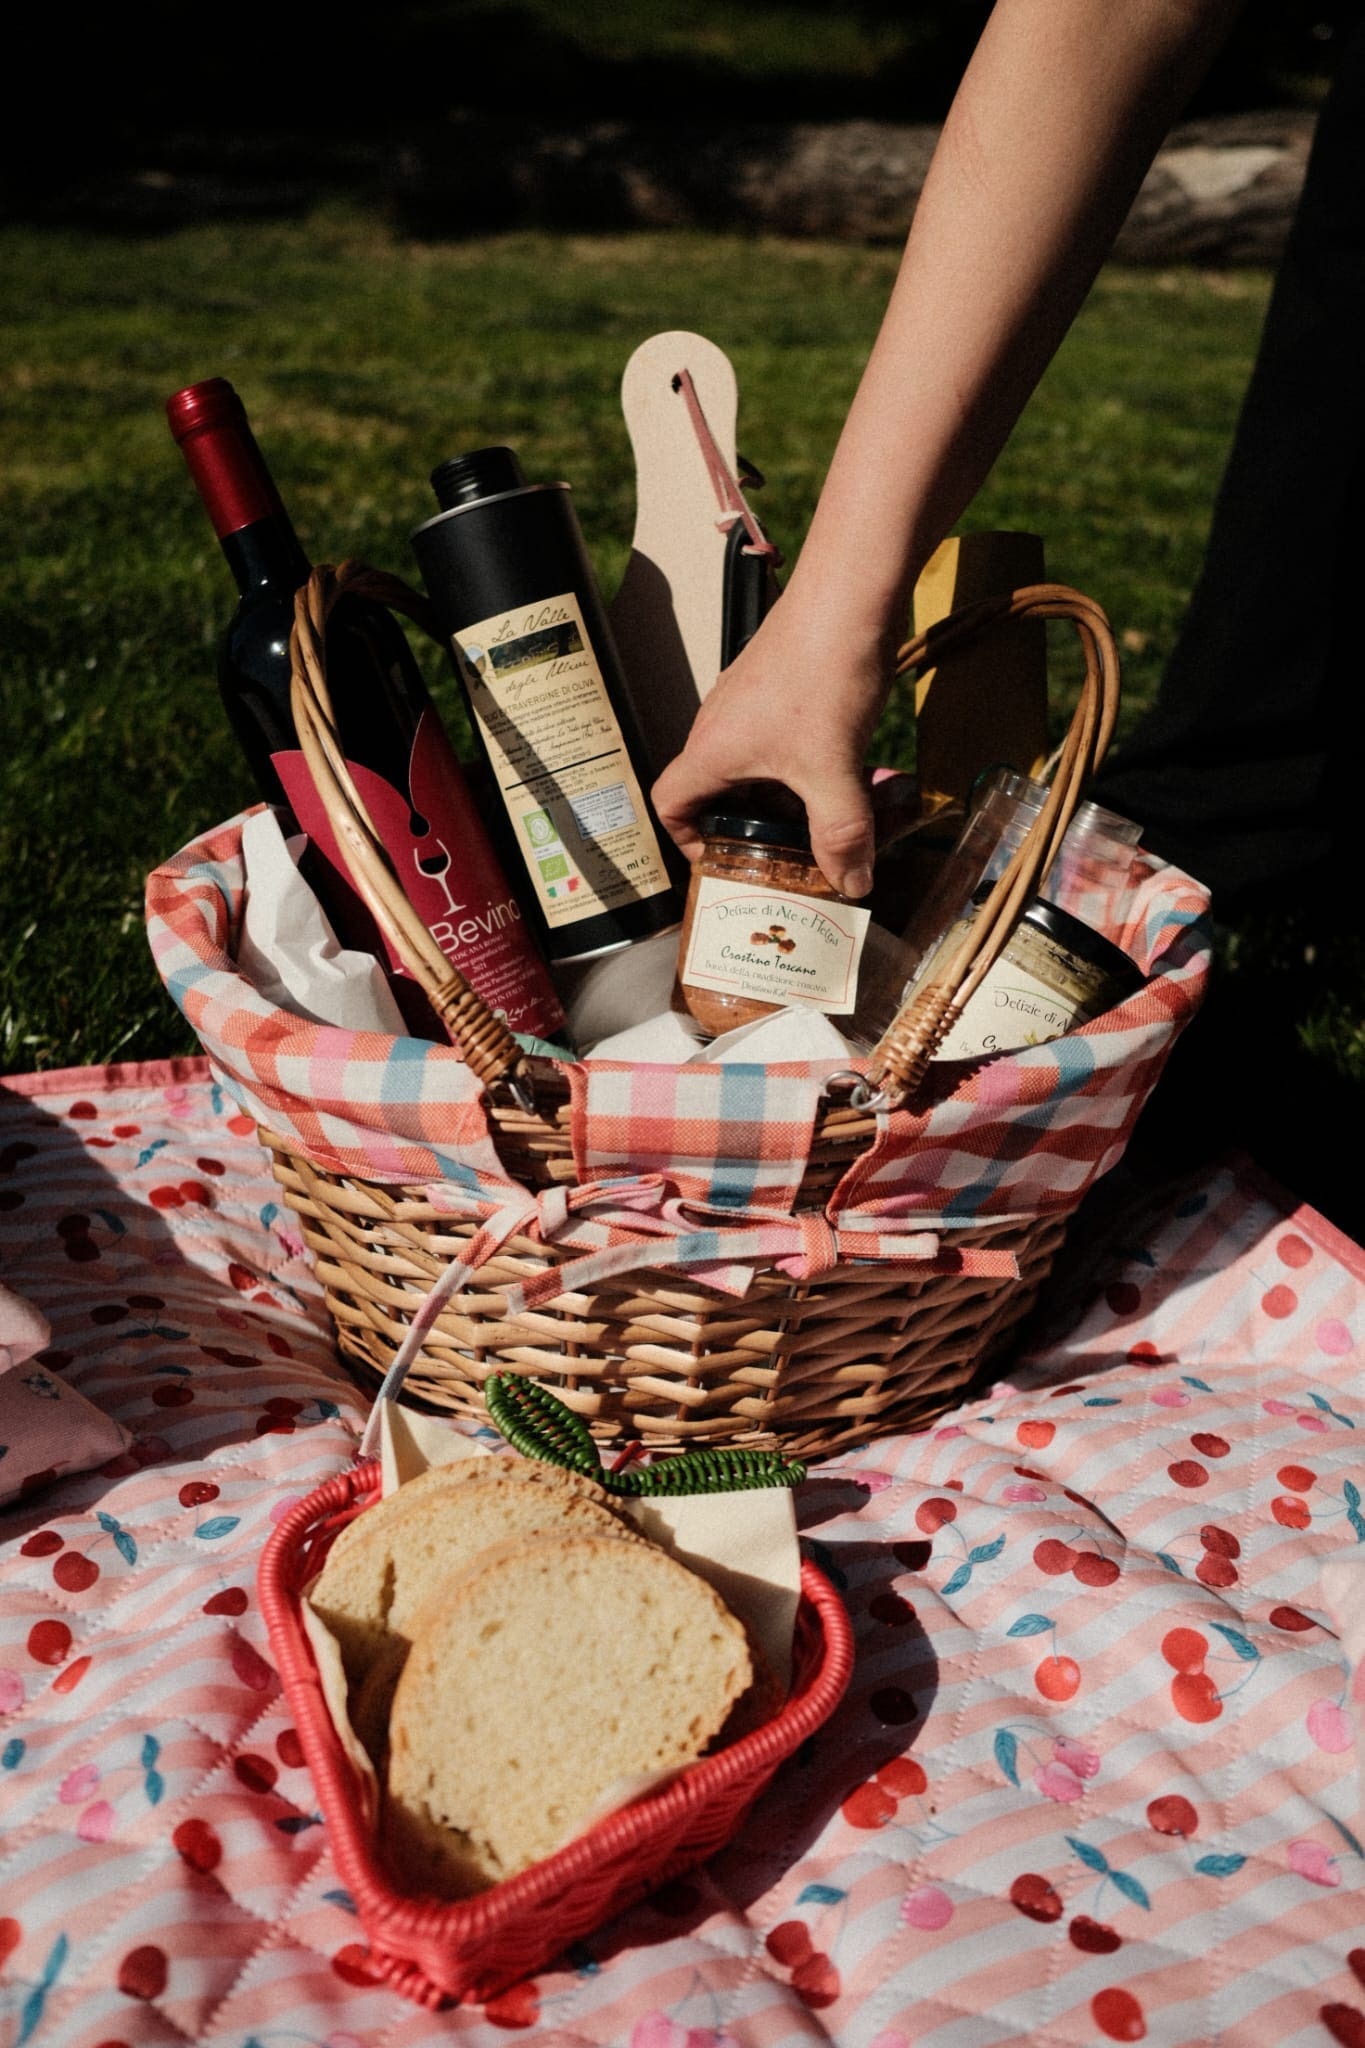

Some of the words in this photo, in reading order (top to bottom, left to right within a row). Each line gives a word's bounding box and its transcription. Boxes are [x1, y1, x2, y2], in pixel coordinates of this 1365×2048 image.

[491, 620, 515, 643] La
[523, 606, 570, 632] Valle
[499, 687, 562, 717] EXTRAVERGINE
[561, 685, 571, 696] DI
[571, 678, 595, 694] OLIVA
[505, 672, 539, 701] degli
[626, 858, 640, 872] ml
[428, 898, 522, 955] Bevino
[714, 903, 757, 921] Delizie
[760, 903, 773, 916] di
[801, 916, 808, 926] e
[810, 913, 840, 948] Helga
[450, 942, 484, 962] TOSCANA
[720, 945, 770, 967] Crostino
[774, 954, 817, 976] Toscano
[993, 989, 1042, 1017] Delizie
[1044, 1007, 1057, 1023] di
